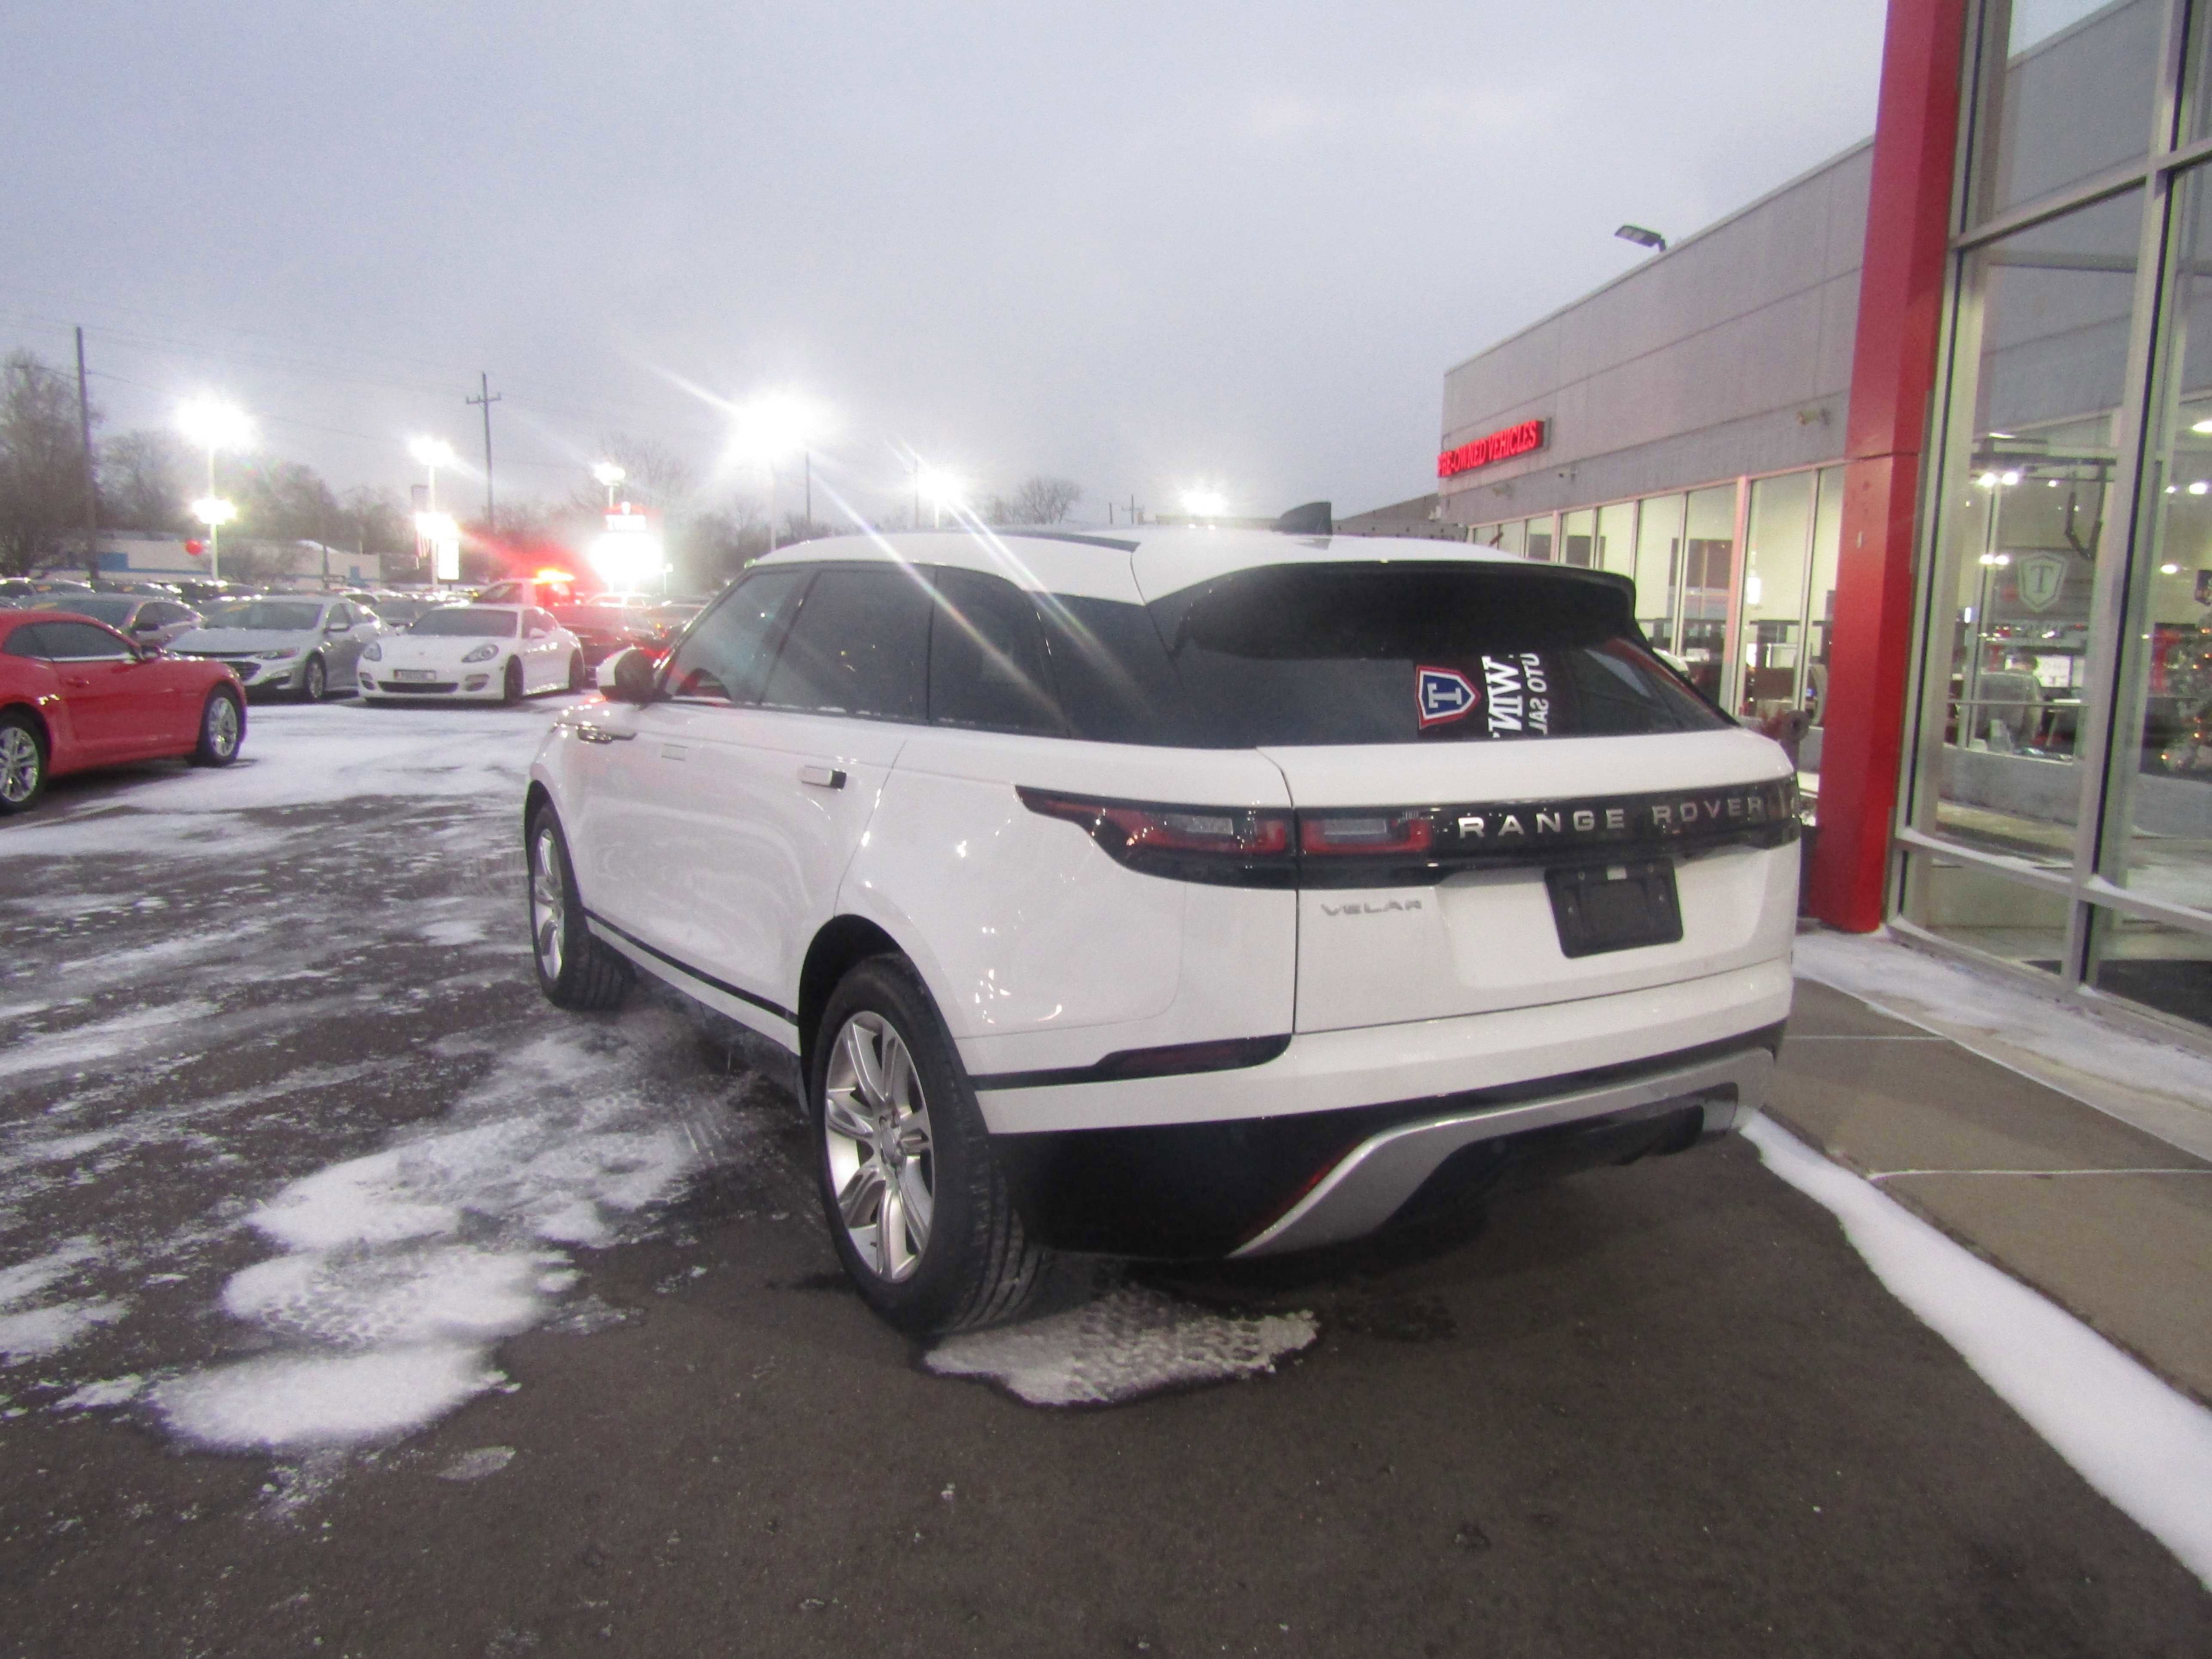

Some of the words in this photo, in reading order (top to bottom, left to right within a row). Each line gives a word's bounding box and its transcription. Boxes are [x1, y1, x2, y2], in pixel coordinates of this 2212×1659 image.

[1488, 420, 1537, 461] VEHICLES
[1458, 808, 1625, 839] RANGE
[1652, 796, 1764, 825] ROVER
[1320, 900, 1422, 916] VELAR
